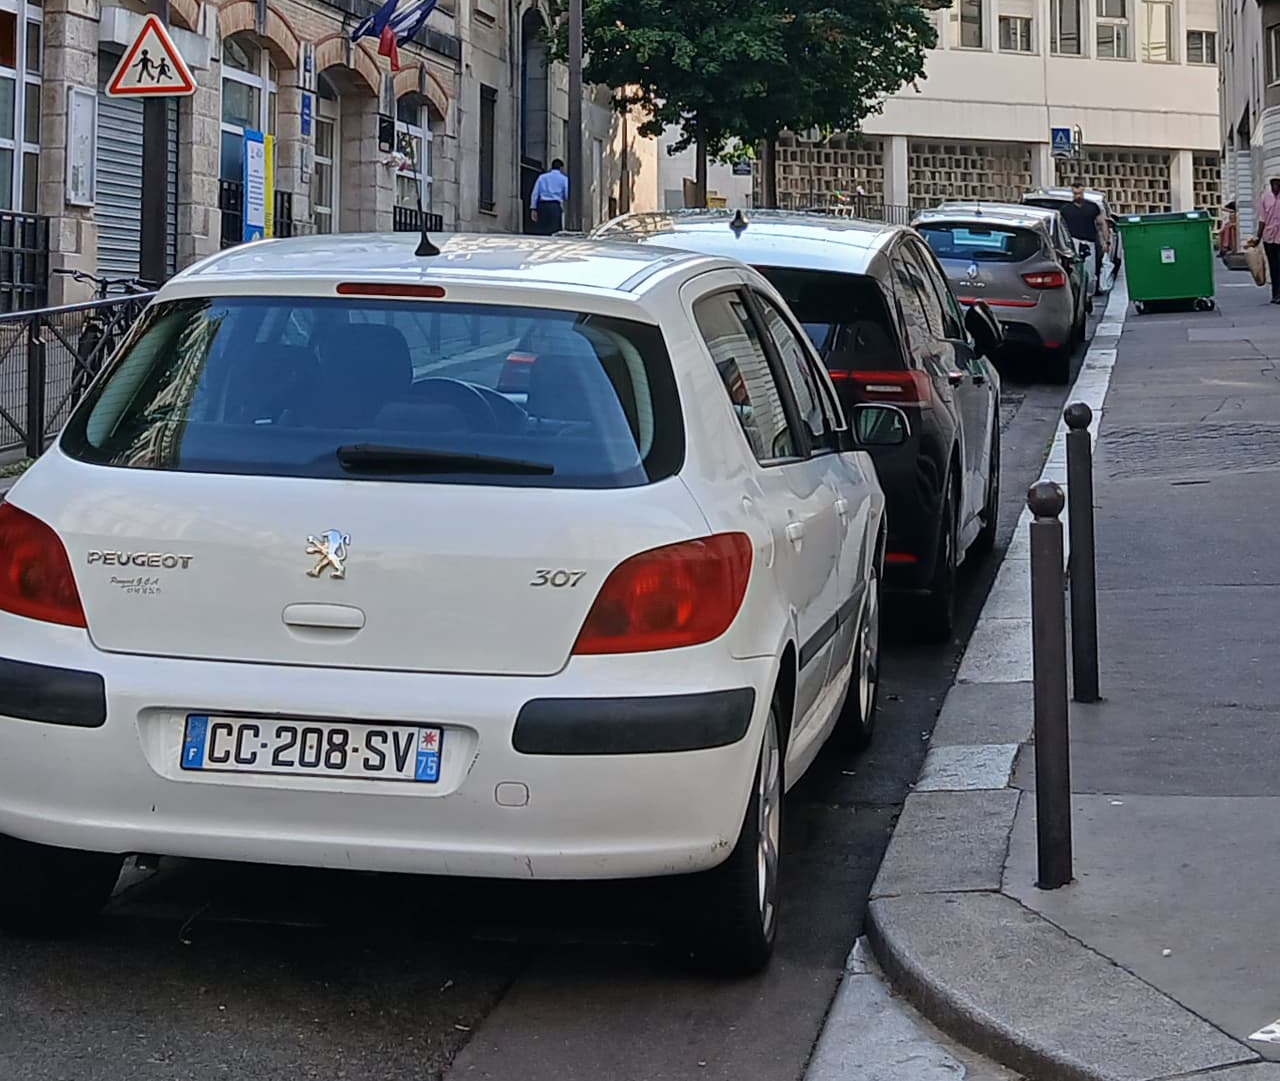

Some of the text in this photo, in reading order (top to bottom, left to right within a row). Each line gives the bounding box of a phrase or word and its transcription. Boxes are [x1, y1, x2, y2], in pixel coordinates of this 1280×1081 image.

[86, 550, 194, 569] PEUGEOT
[529, 568, 588, 588] 307
[187, 748, 197, 761] F
[417, 755, 438, 777] 75
